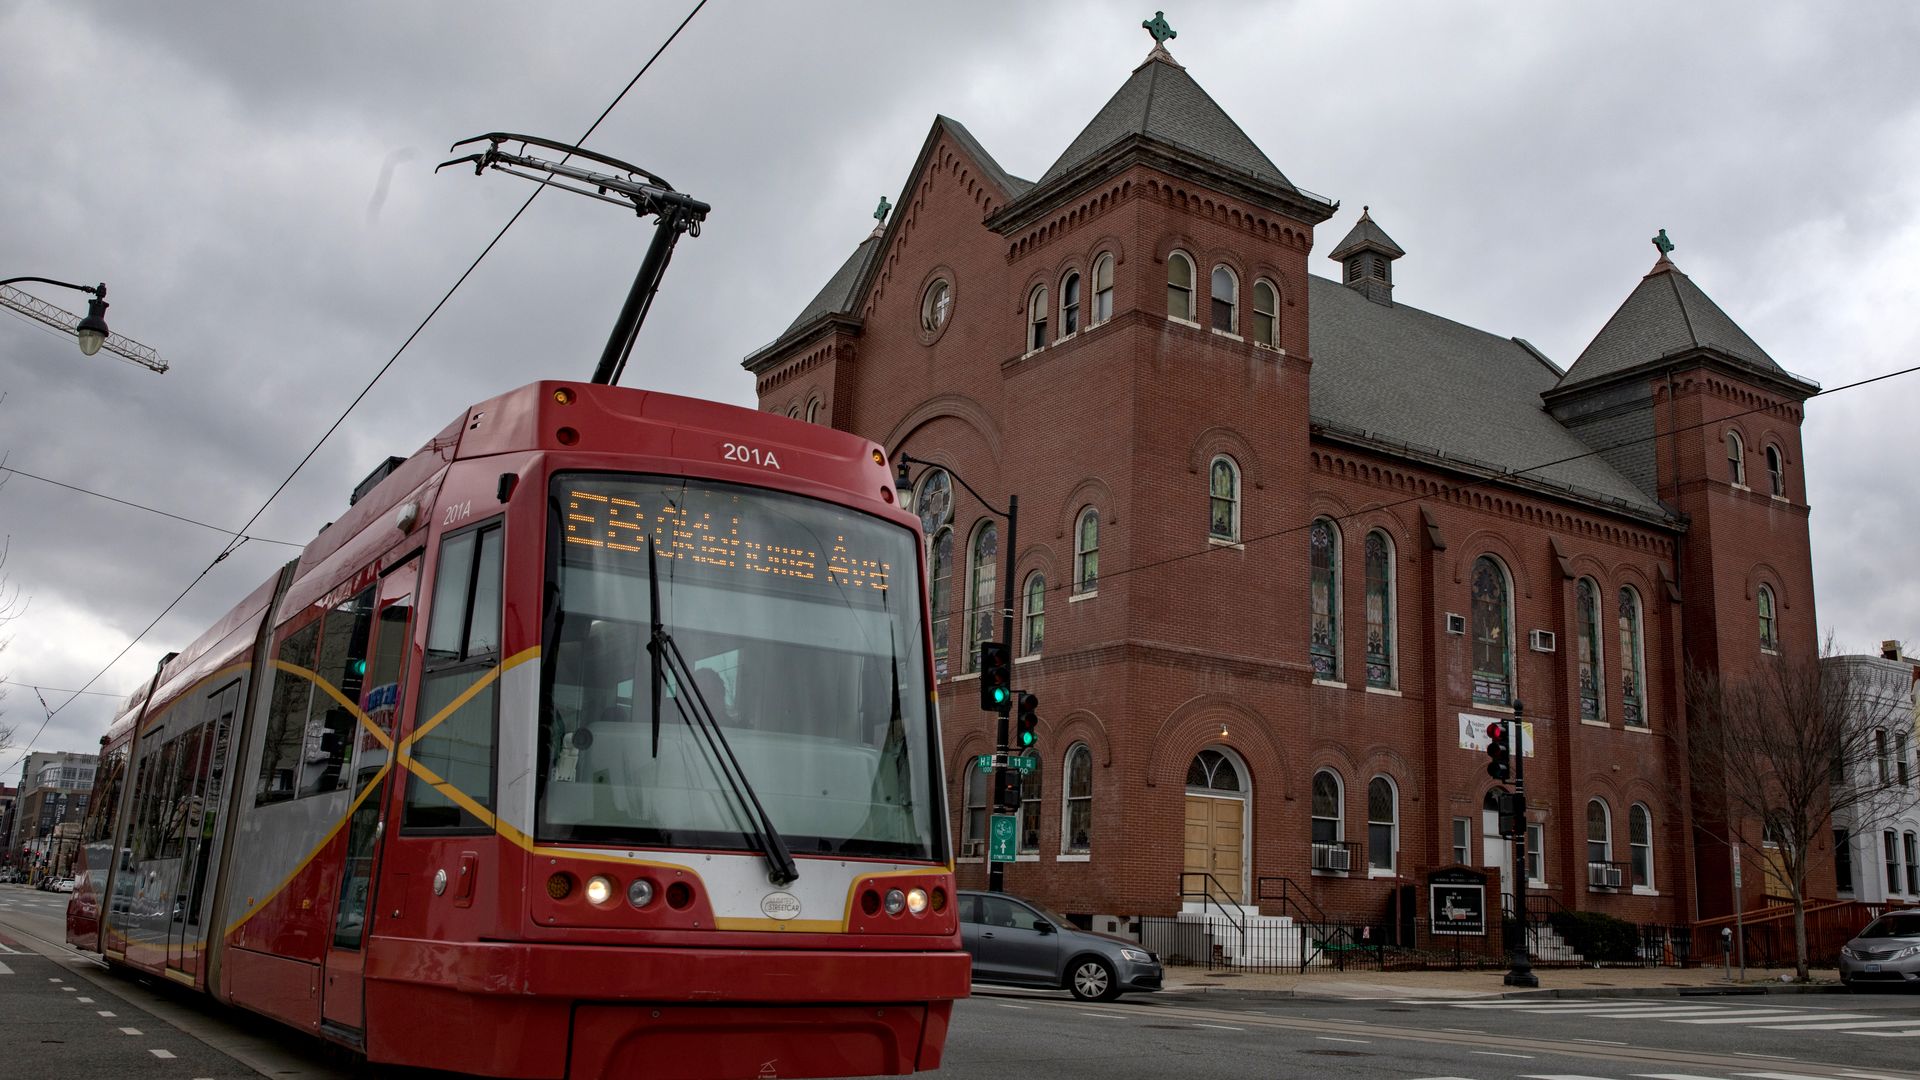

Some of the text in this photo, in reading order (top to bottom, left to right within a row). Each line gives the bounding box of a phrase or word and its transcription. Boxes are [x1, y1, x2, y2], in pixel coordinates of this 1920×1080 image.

[723, 442, 781, 470] 201A
[443, 500, 472, 526] 201A
[566, 490, 644, 553] EB
[827, 526, 891, 591] Ave
[980, 757, 986, 766] H
[1013, 757, 1021, 767] 11
